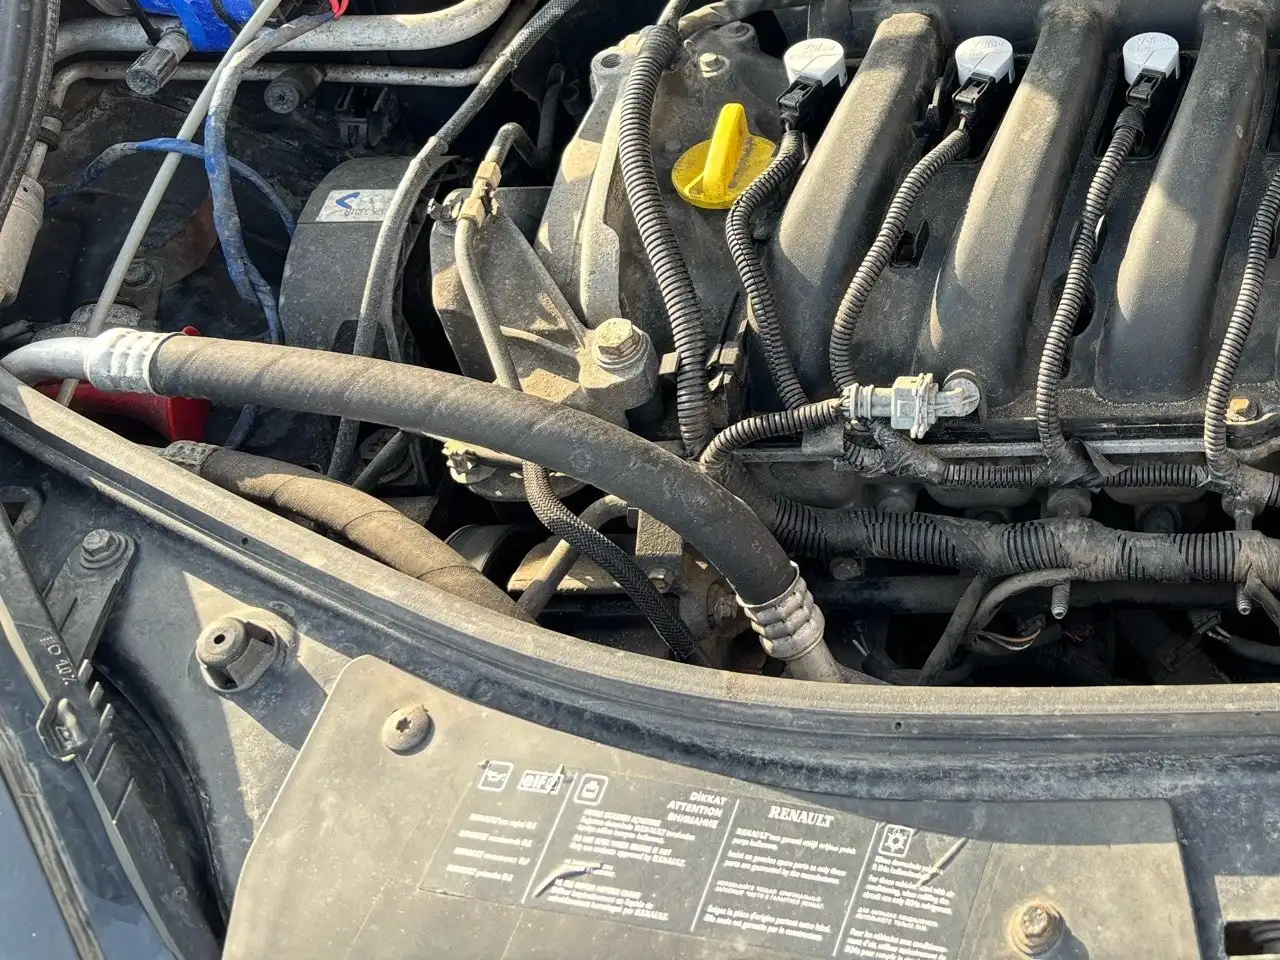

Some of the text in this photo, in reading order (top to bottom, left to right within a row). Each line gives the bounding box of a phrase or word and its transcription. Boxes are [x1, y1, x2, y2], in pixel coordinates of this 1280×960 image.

[667, 800, 723, 818] ATTENTION
[767, 805, 835, 828] RENAULT
[666, 812, 720, 829] ВНИМАНИЕ
